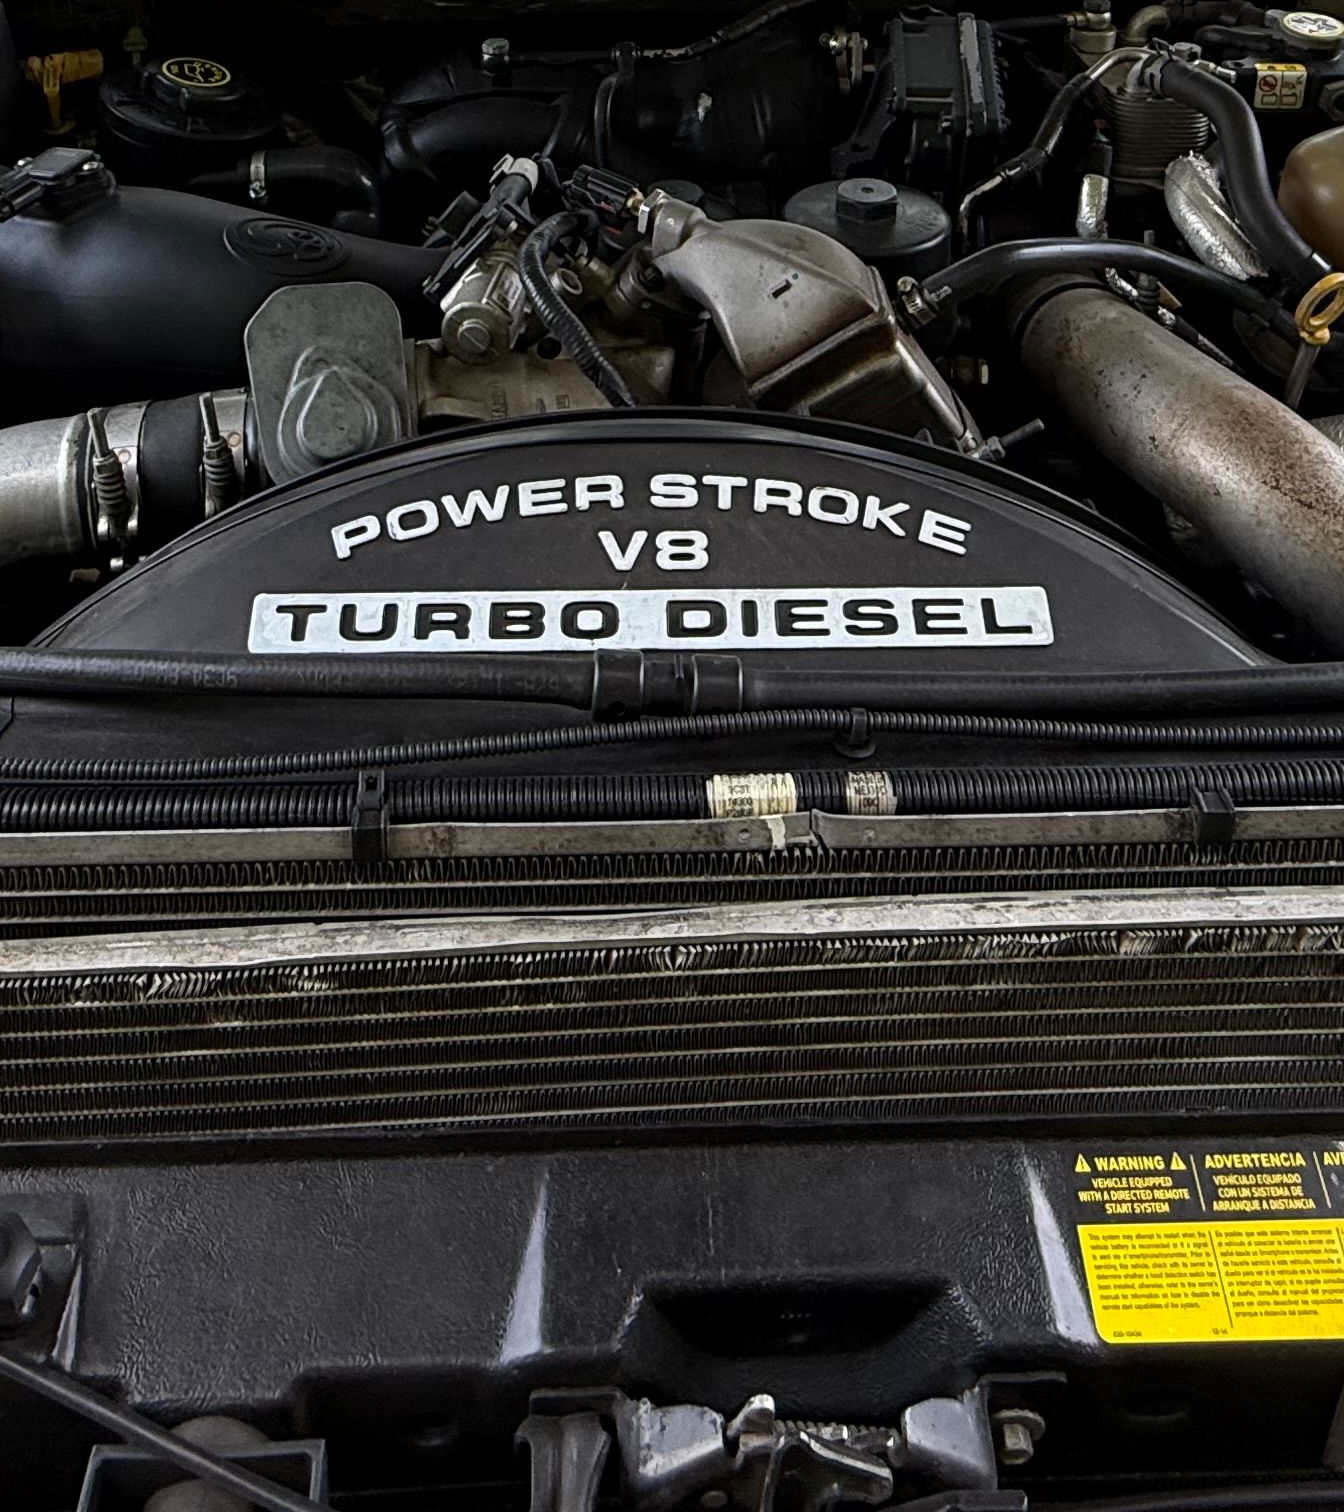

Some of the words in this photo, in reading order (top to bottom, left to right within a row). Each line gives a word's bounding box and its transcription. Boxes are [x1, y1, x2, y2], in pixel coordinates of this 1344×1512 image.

[331, 474, 626, 561] POWER
[649, 473, 973, 557] STROKE
[598, 529, 711, 572] V8
[273, 598, 620, 644] TURBO
[665, 596, 1034, 640] DIESEL
[1094, 1155, 1165, 1172] WARNING
[1204, 1152, 1306, 1169] ADVERTENCIA
[1091, 1177, 1129, 1189] VEHICLE
[1129, 1176, 1173, 1188] EQUIPPED
[1257, 1173, 1302, 1185] EQUIPADO
[1078, 1191, 1102, 1202] WITH
[1103, 1190, 1110, 1202] A
[1110, 1189, 1153, 1201] DIRECTED
[1154, 1188, 1191, 1200] REMOTE
[1217, 1187, 1237, 1199] CON
[1237, 1187, 1251, 1198] UN
[1251, 1186, 1290, 1198] SISTEMA
[1291, 1186, 1305, 1197] DE
[1105, 1203, 1133, 1215] START
[1133, 1202, 1171, 1214] SYSTEM
[1212, 1199, 1260, 1213] ARRANQUE
[1261, 1199, 1269, 1211] A
[1269, 1198, 1317, 1211] DISTANCIA
